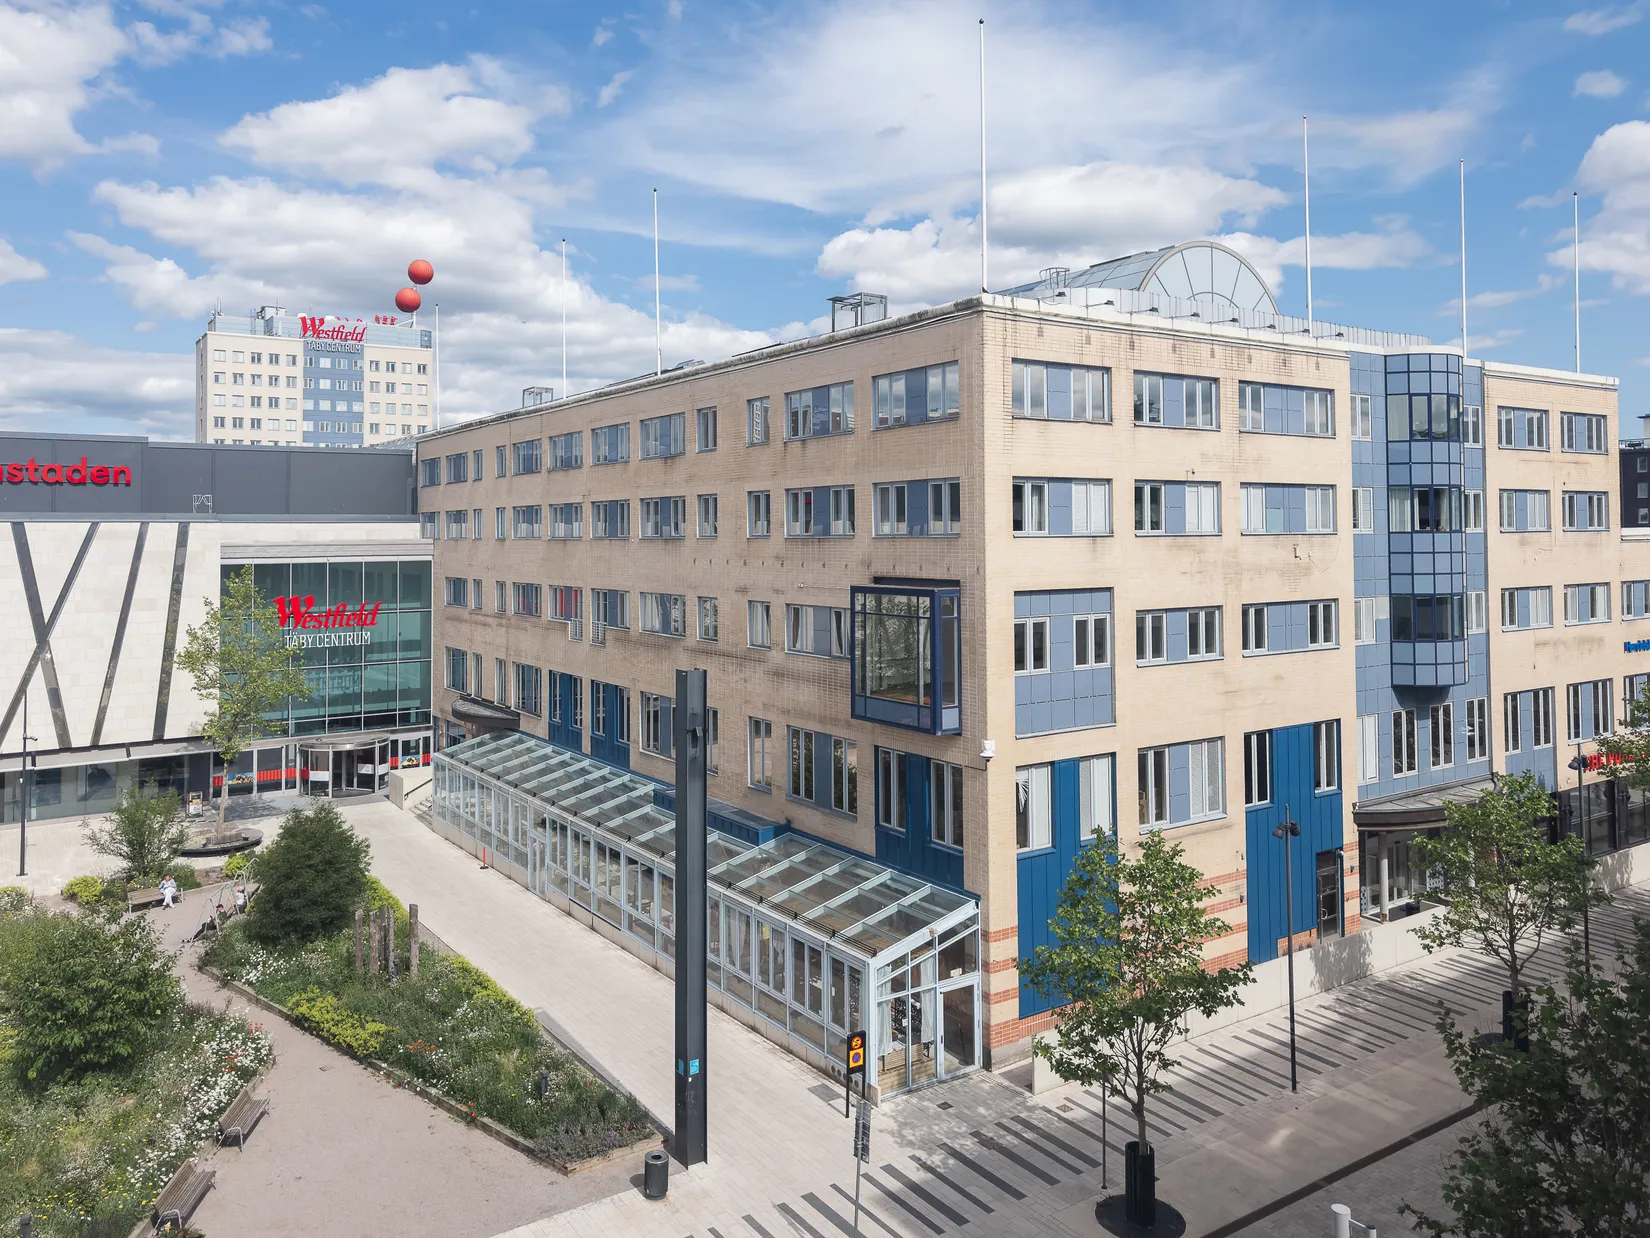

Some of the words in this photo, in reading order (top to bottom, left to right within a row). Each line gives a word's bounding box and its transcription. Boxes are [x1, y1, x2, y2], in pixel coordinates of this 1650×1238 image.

[300, 316, 367, 342] Westfield
[326, 342, 361, 353] CENTRUM
[271, 594, 383, 630] Westfield
[284, 632, 314, 649] TÄBY
[316, 631, 371, 648] CENTRUM
